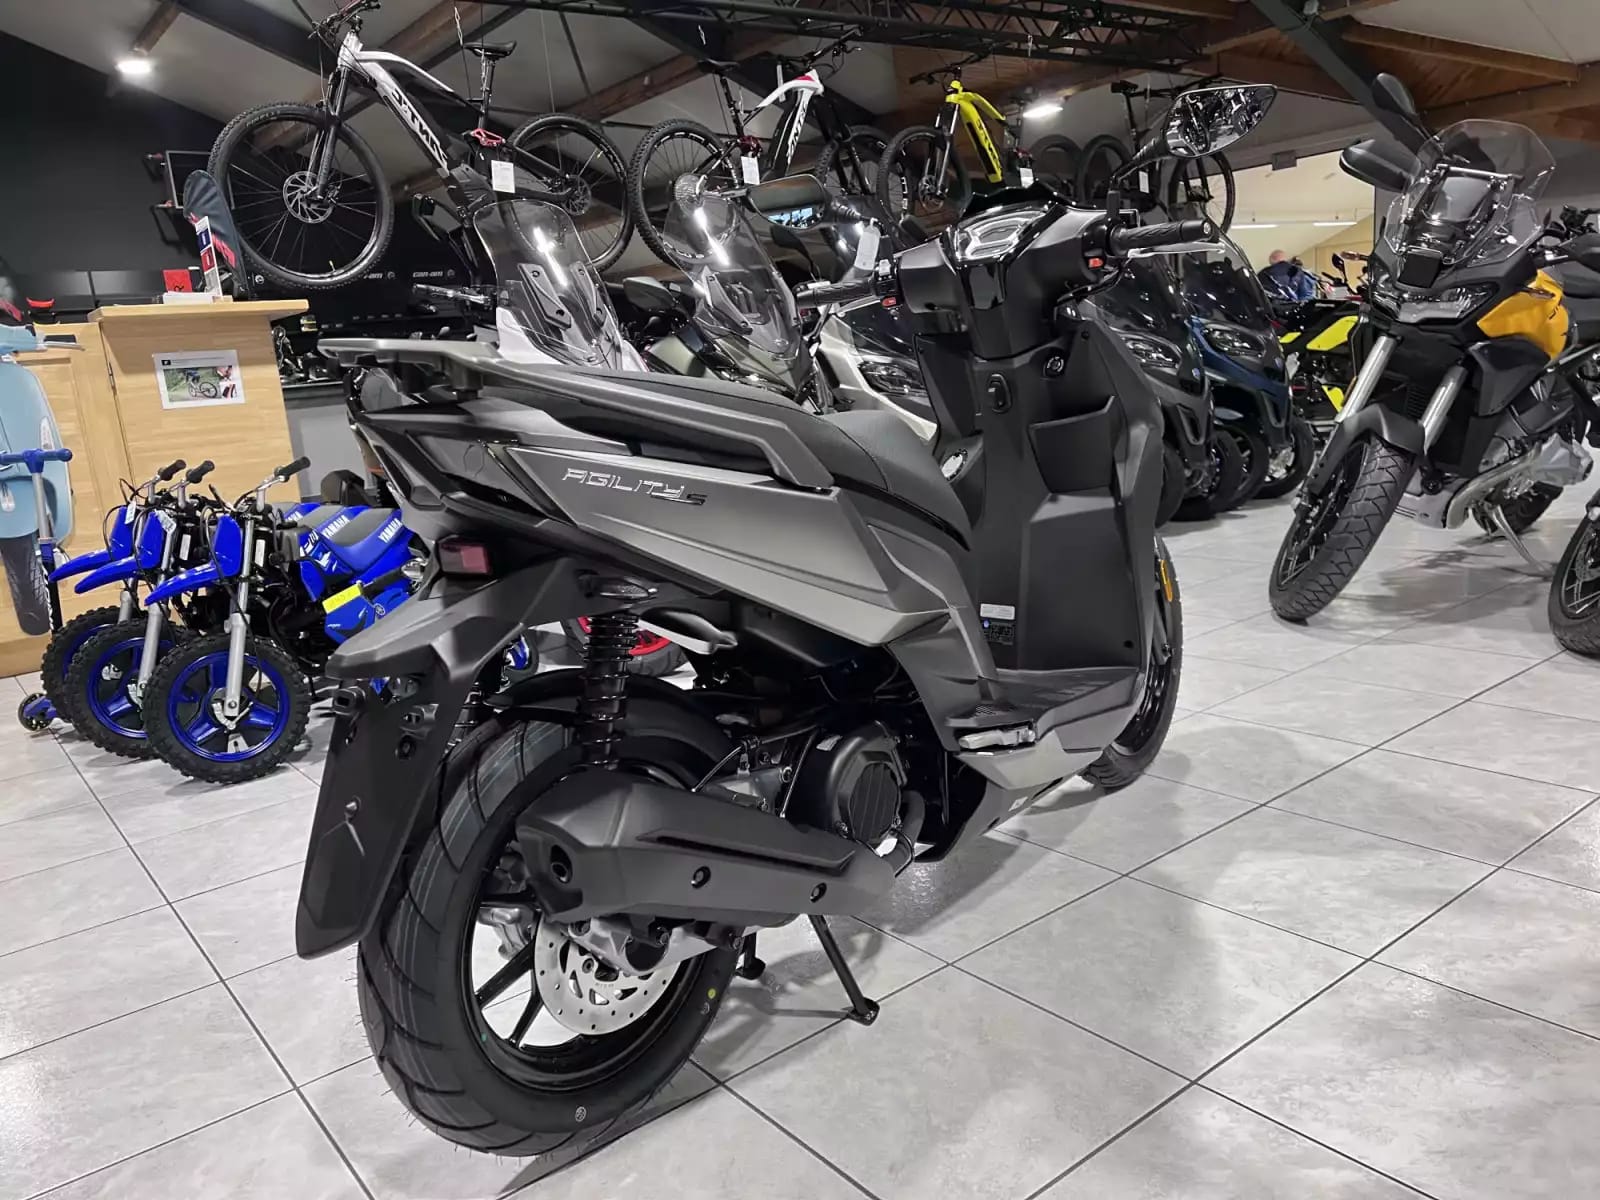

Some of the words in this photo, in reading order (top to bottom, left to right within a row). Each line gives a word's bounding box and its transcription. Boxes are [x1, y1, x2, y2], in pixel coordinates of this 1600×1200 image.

[562, 467, 685, 498] AGILITY
[321, 514, 351, 540] YAMAHA
[377, 517, 403, 544] YAMAHA
